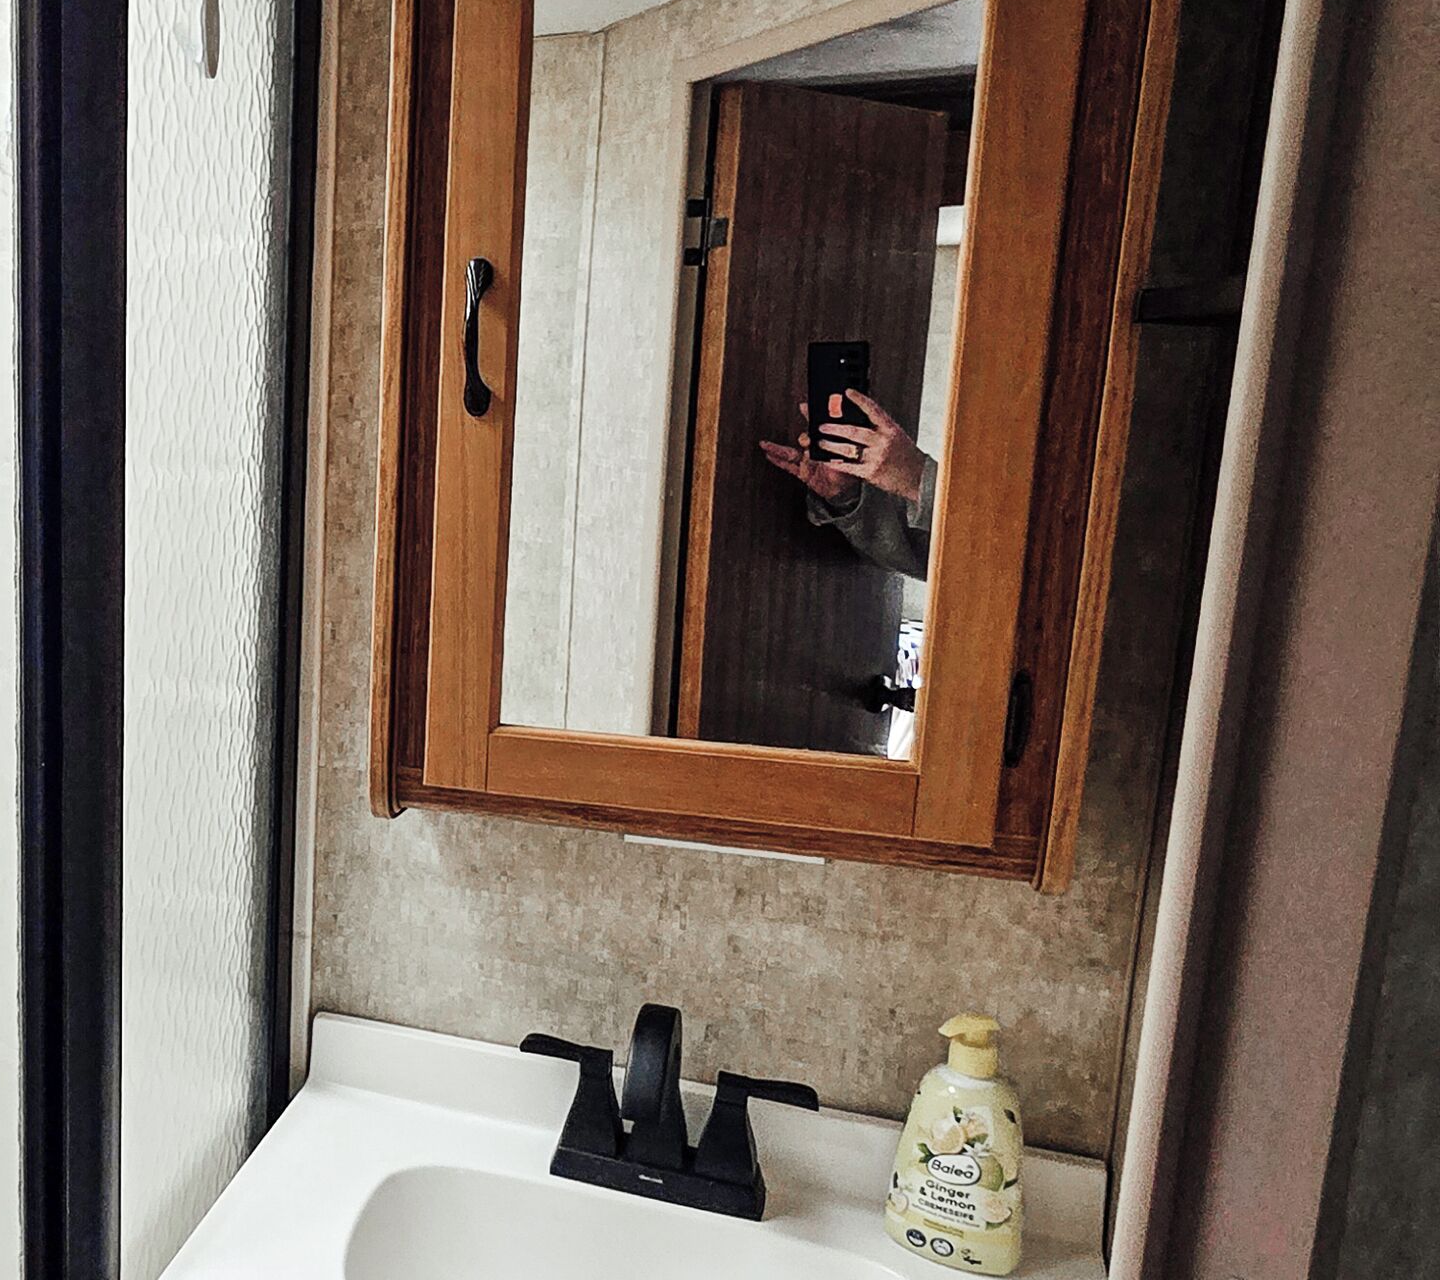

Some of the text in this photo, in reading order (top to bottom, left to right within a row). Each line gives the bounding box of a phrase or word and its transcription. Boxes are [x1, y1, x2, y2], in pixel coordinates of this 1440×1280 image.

[931, 1159, 974, 1179] Balea
[925, 1179, 971, 1199] Ginger
[930, 1191, 976, 1211] Lemon
